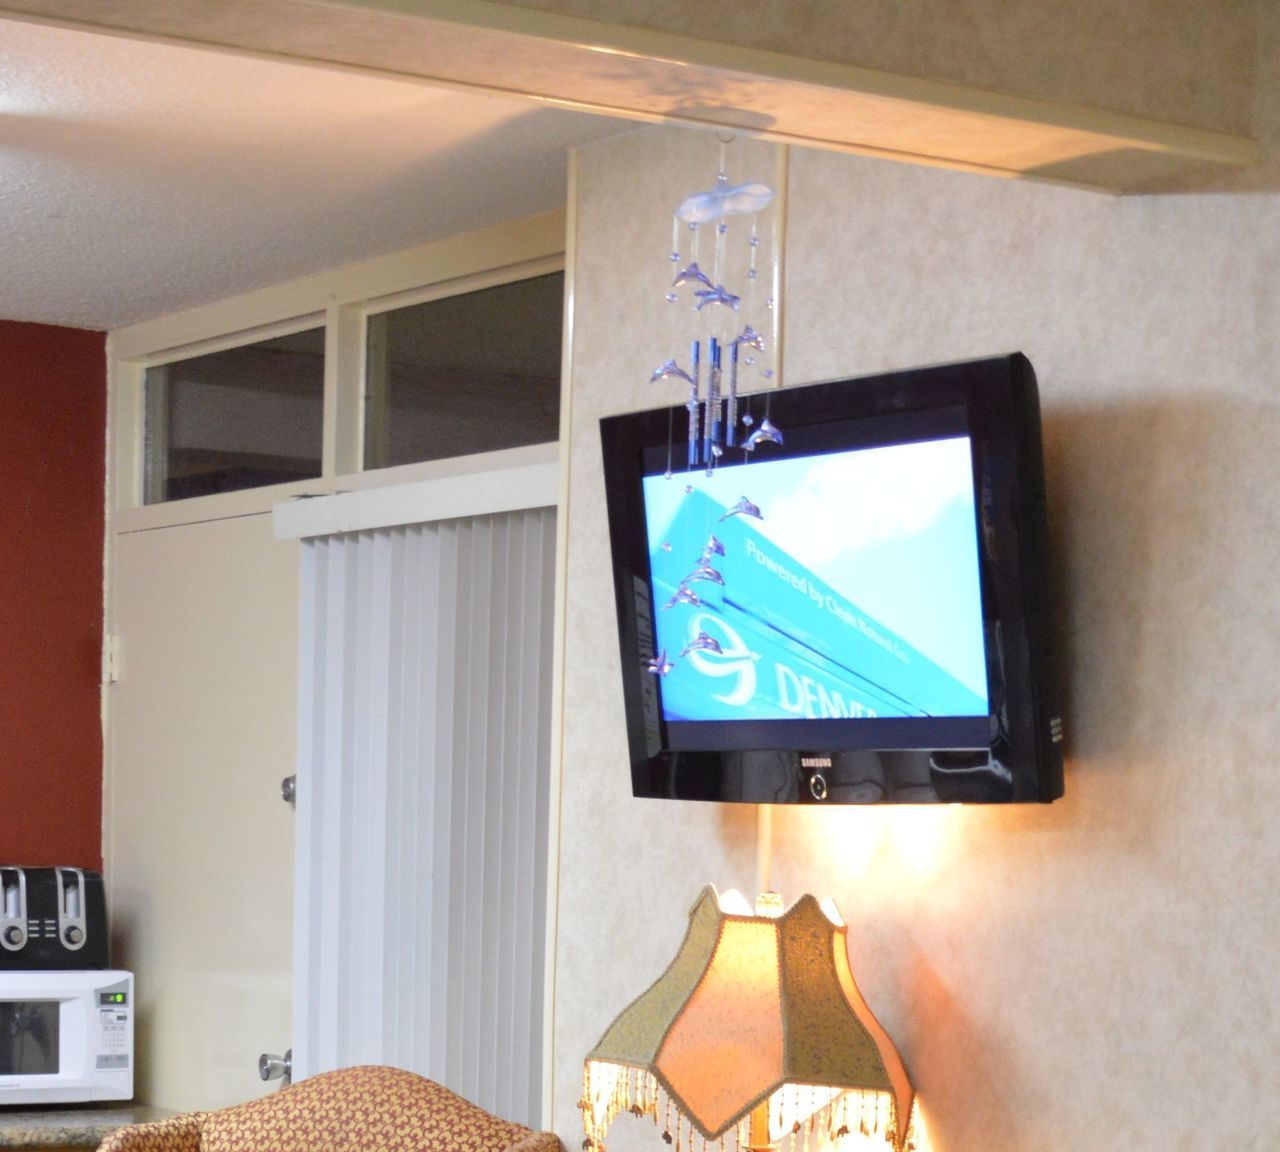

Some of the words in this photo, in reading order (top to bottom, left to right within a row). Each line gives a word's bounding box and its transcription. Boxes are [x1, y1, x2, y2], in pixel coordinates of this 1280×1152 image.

[745, 538, 808, 594] Powered
[808, 582, 824, 608] by
[801, 758, 832, 768] SAMSUNG
